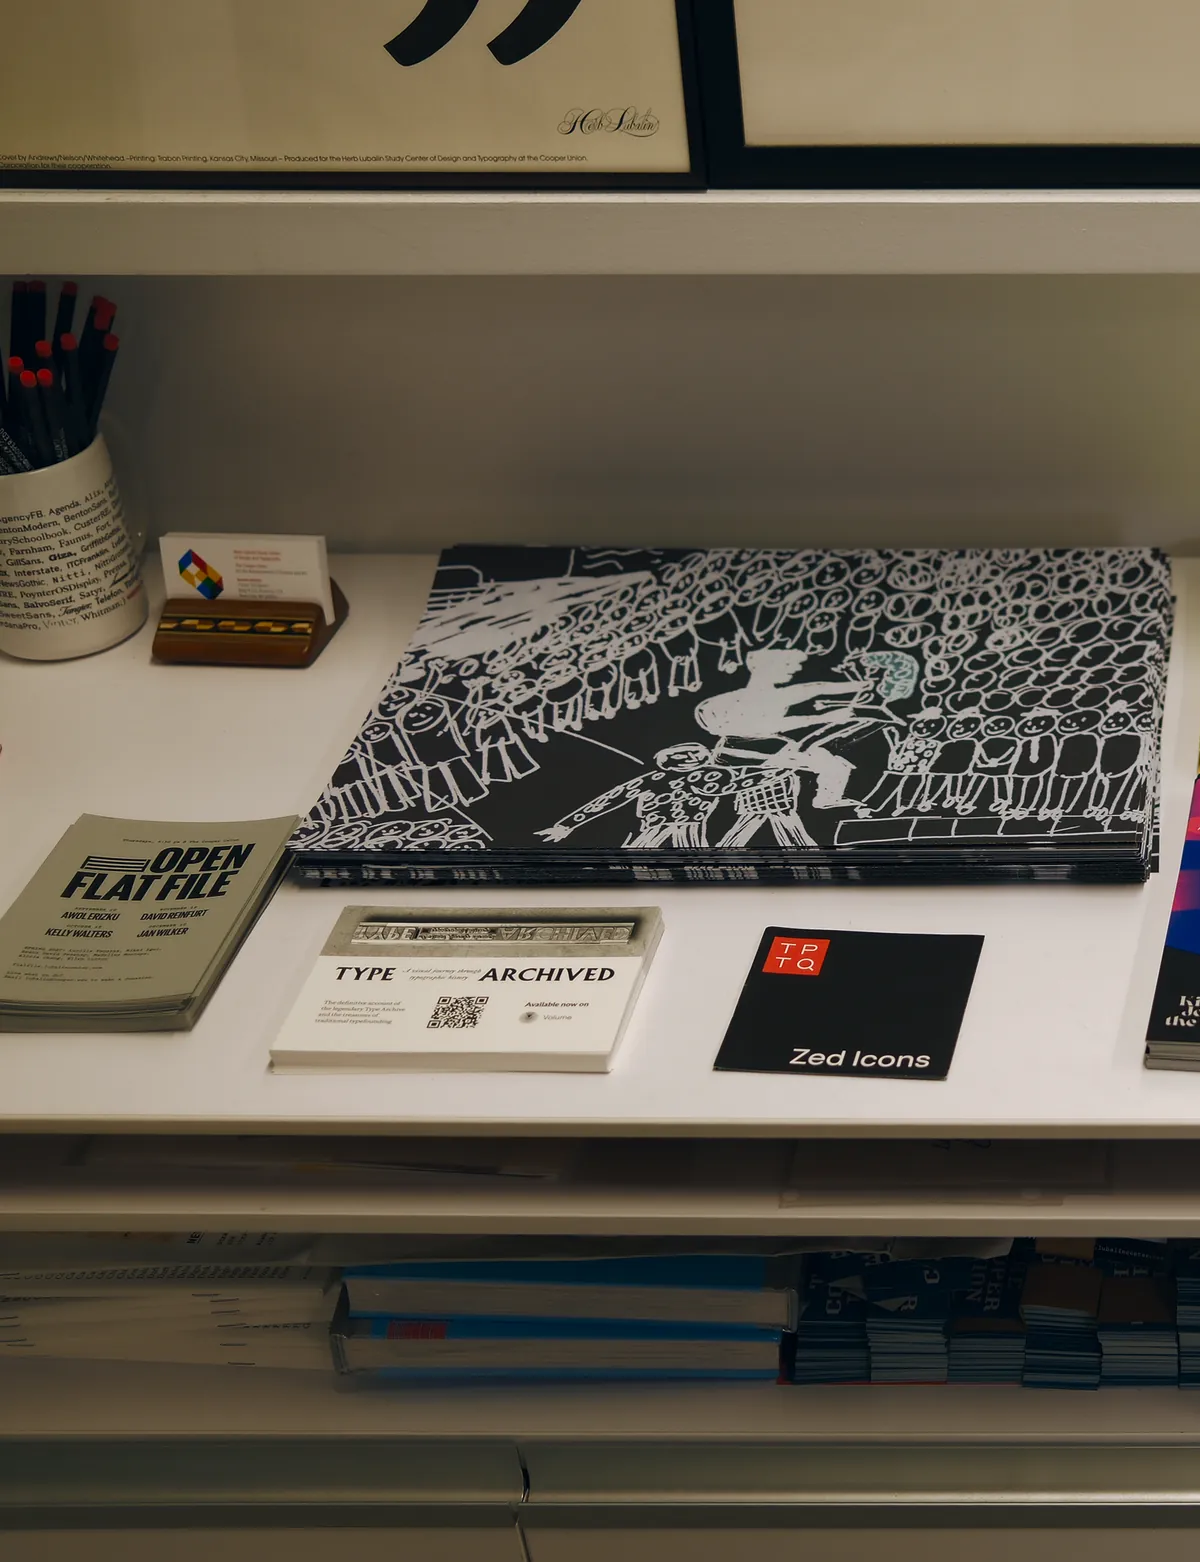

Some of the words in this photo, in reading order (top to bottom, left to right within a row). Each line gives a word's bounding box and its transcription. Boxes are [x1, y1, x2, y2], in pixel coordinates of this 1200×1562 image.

[605, 106, 660, 138] Lubalin
[210, 154, 234, 163] Kansas
[250, 154, 278, 163] Missouri
[284, 154, 319, 163] Produced
[319, 154, 329, 163] for
[329, 154, 341, 163] the
[342, 154, 358, 163] Herb
[359, 154, 385, 163] Lubalin
[385, 154, 404, 163] Study
[405, 154, 429, 163] Center
[429, 154, 437, 163] of
[437, 154, 462, 163] Design
[462, 154, 477, 163] and
[477, 154, 517, 163] Typography
[518, 154, 526, 163] at
[526, 154, 539, 163] the
[539, 154, 567, 163] Cooper
[150, 843, 256, 873] OPEN
[60, 871, 163, 901] FLAT
[155, 870, 239, 901] FILE
[60, 911, 87, 920] AWOL
[140, 912, 168, 921] DAVID
[45, 928, 73, 937] KELLY
[72, 929, 113, 938] WALTERS
[136, 929, 156, 938] JAN
[155, 927, 189, 937] WILKER
[335, 966, 397, 981] TYPE
[478, 967, 615, 982] ARCHIVED
[1165, 1015, 1197, 1027] the
[789, 1048, 846, 1067] Zed
[852, 1050, 931, 1068] Icons
